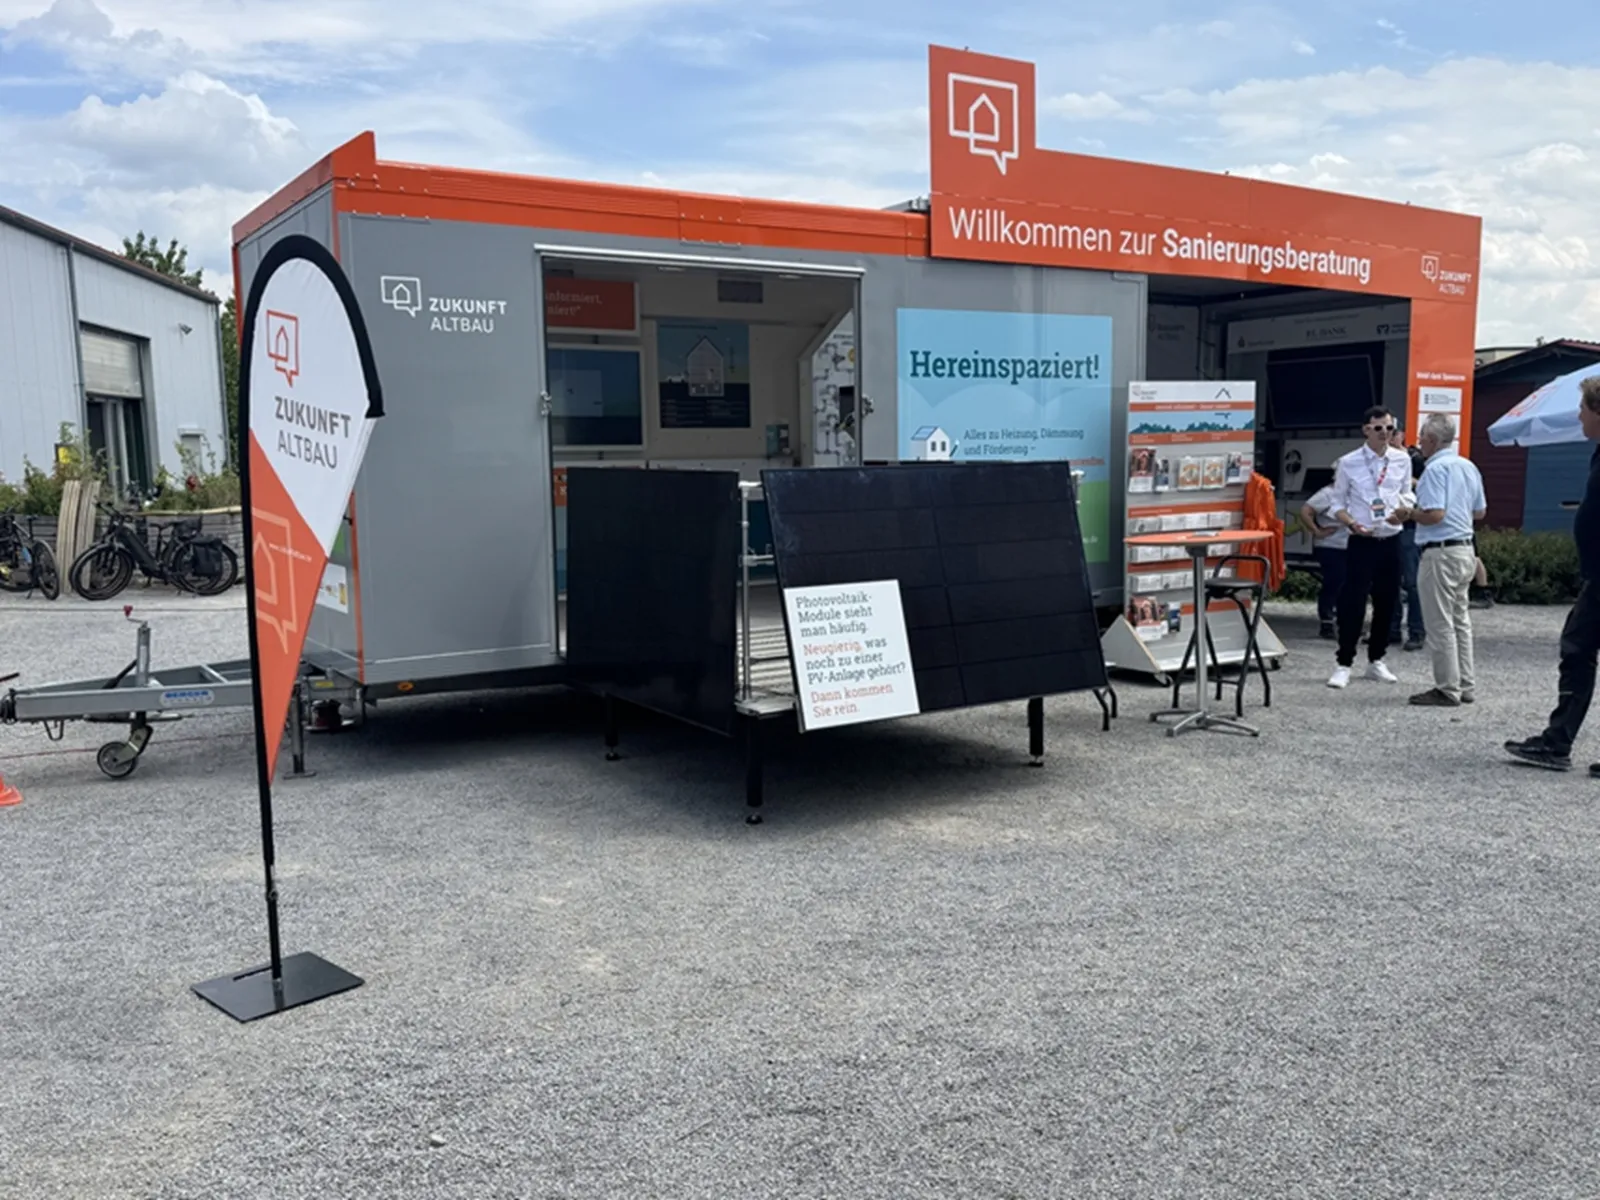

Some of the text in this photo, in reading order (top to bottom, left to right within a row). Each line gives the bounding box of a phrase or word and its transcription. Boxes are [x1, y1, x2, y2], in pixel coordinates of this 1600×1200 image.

[948, 206, 1371, 285] Willkommen zur Sanierungsberatung
[428, 297, 507, 315] ZUKUNFT
[430, 316, 495, 334] ALTBAU
[909, 350, 1100, 385] Hereinspaziert!
[274, 396, 352, 438] ZUKUNFT
[964, 429, 987, 441] Alles
[989, 431, 1000, 441] zu
[277, 430, 338, 469] ALTBAU
[964, 445, 981, 456] und
[983, 444, 1029, 457] Förderung
[795, 591, 872, 609] Photovoltaik-
[798, 605, 873, 624] Module sieht
[800, 626, 828, 638] man
[864, 638, 888, 649] was
[806, 652, 884, 671] noch zu einer
[807, 661, 907, 686] PV-Anlage gehört?
[811, 683, 894, 704] Dann kommen
[813, 705, 832, 718] Sie
